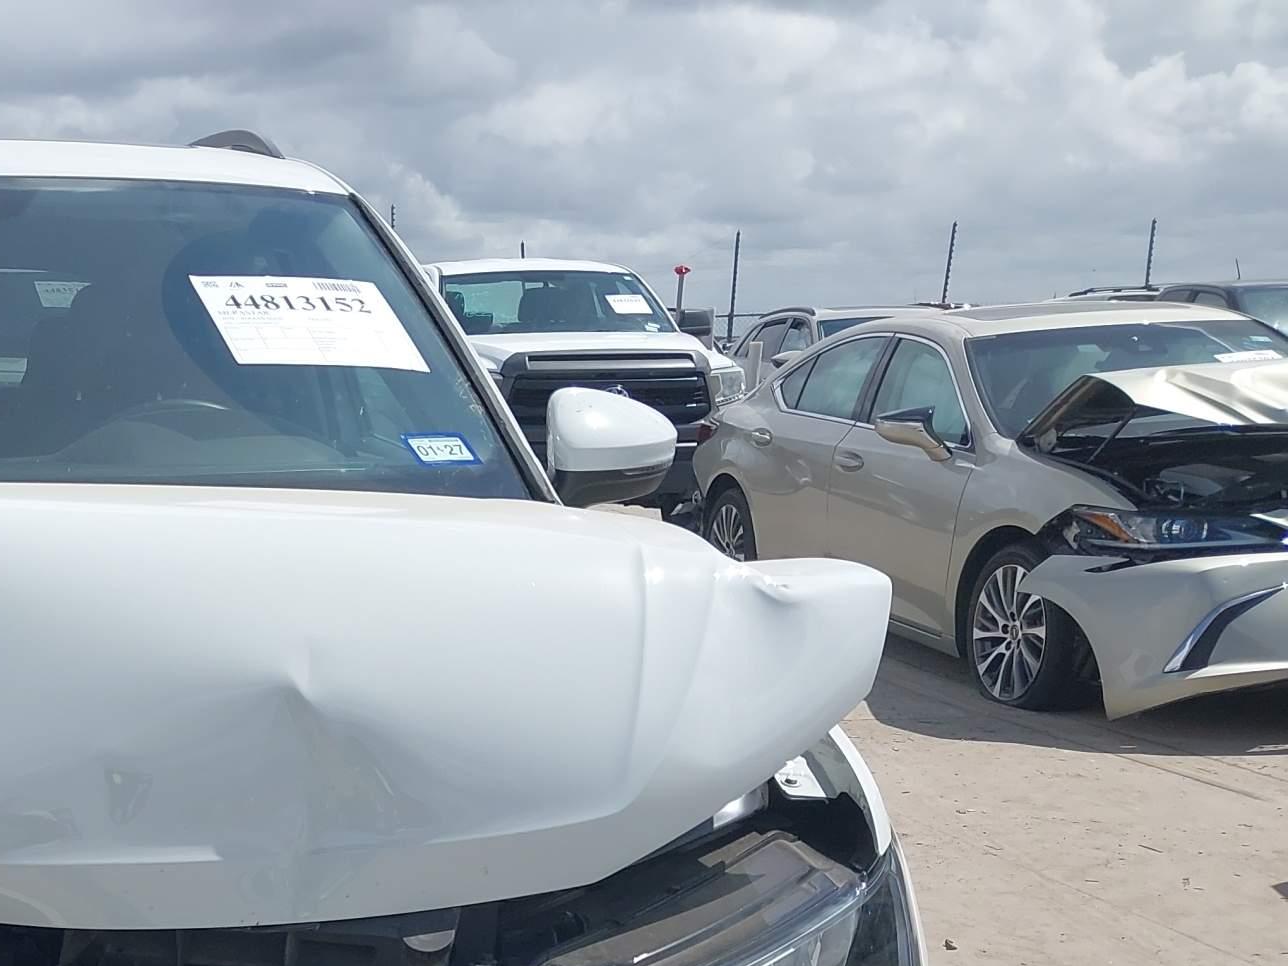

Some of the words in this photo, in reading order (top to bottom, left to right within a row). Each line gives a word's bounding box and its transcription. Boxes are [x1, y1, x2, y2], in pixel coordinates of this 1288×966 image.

[224, 293, 373, 315] 44813152
[416, 445, 438, 457] 01
[444, 444, 464, 456] 27
